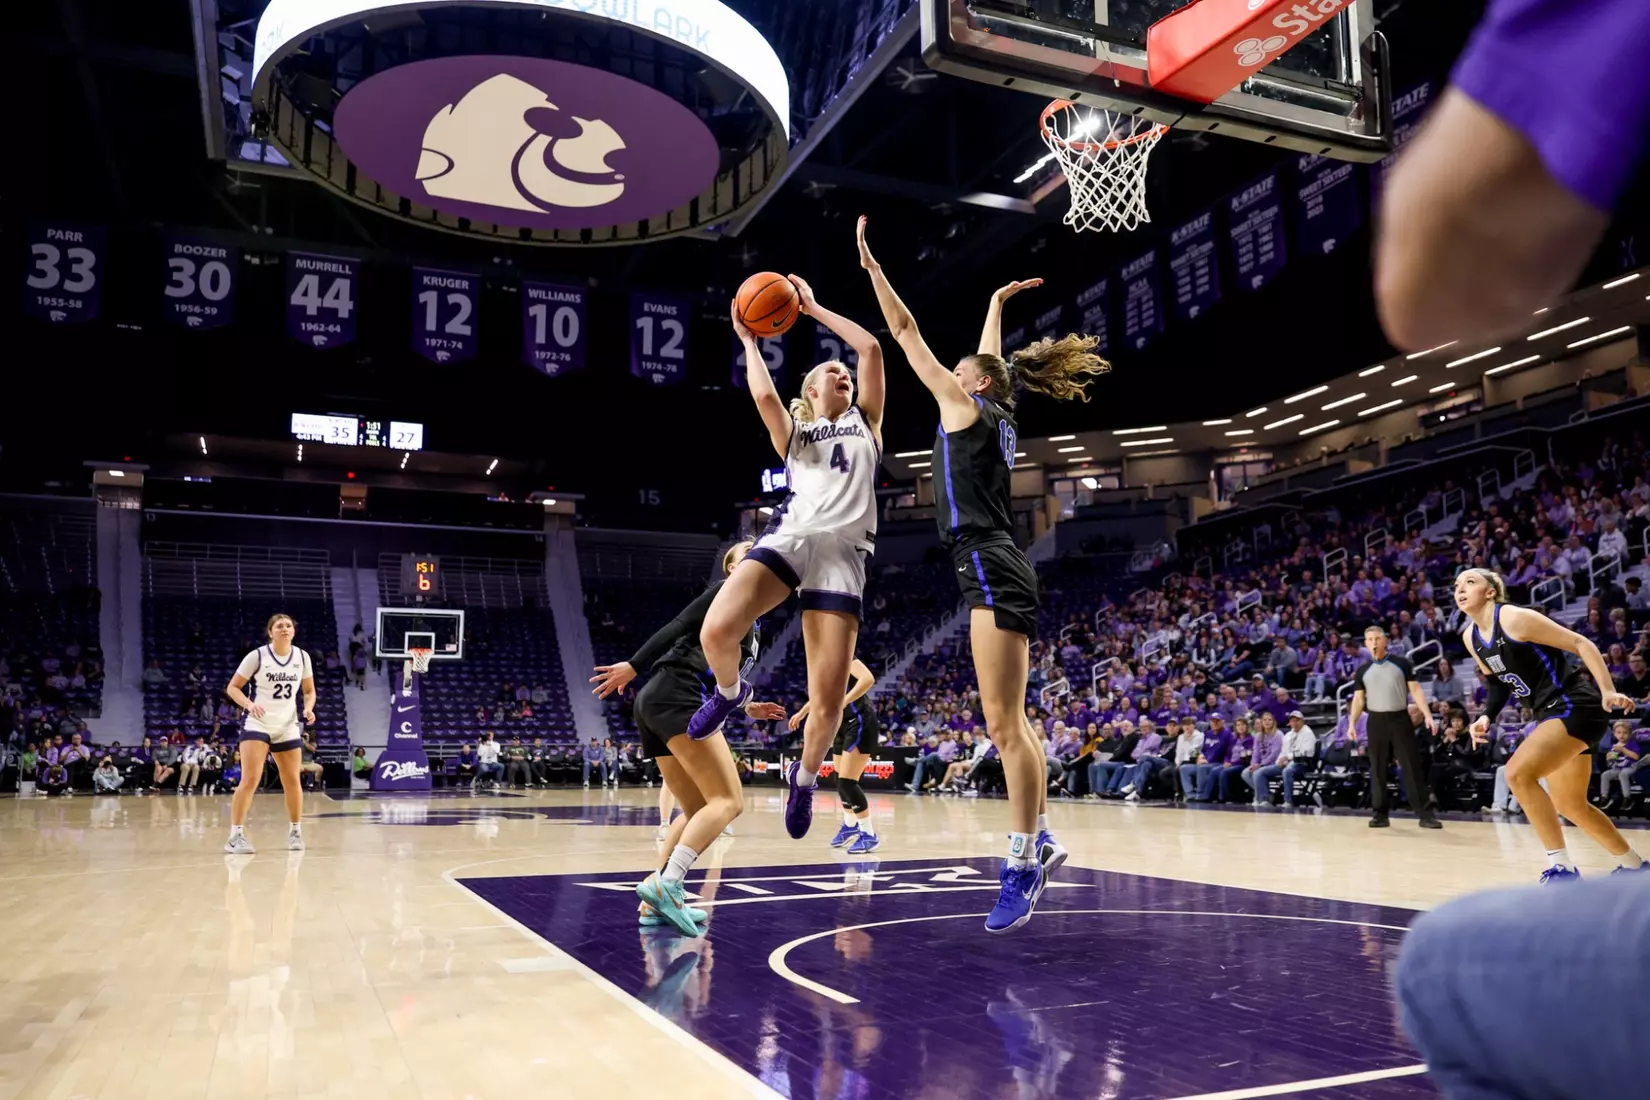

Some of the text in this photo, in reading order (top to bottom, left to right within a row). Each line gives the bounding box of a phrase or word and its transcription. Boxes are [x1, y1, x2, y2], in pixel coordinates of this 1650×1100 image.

[1391, 82, 1429, 114] TATE
[1231, 175, 1275, 210] K-STATE
[46, 228, 83, 243] PARR
[174, 243, 227, 259] BOOZER
[26, 243, 97, 294] 33
[295, 259, 353, 275] MURRELL
[164, 257, 232, 302] 30
[422, 274, 469, 290] KRUGER
[36, 296, 83, 309] 1955-58
[290, 274, 354, 319] 44
[528, 287, 582, 304] WILLIAMS
[174, 303, 218, 316] 1956-59
[418, 290, 472, 336] 12
[643, 301, 678, 316] EVANS
[300, 321, 341, 333] 1962-64
[528, 303, 580, 347] 10
[424, 337, 463, 350] 1971-74
[635, 316, 685, 359] 12
[534, 350, 571, 362] 1972-76
[736, 332, 784, 370] 5
[641, 361, 678, 373] 1974-78
[331, 426, 349, 438] 35
[397, 432, 415, 443] 27
[801, 424, 865, 447] Wildcats
[999, 419, 1017, 469] 13
[829, 443, 850, 474] 4
[638, 488, 661, 506] 15
[266, 672, 298, 682] Wildcats
[273, 683, 292, 700] 23
[380, 761, 429, 781] Dillons
